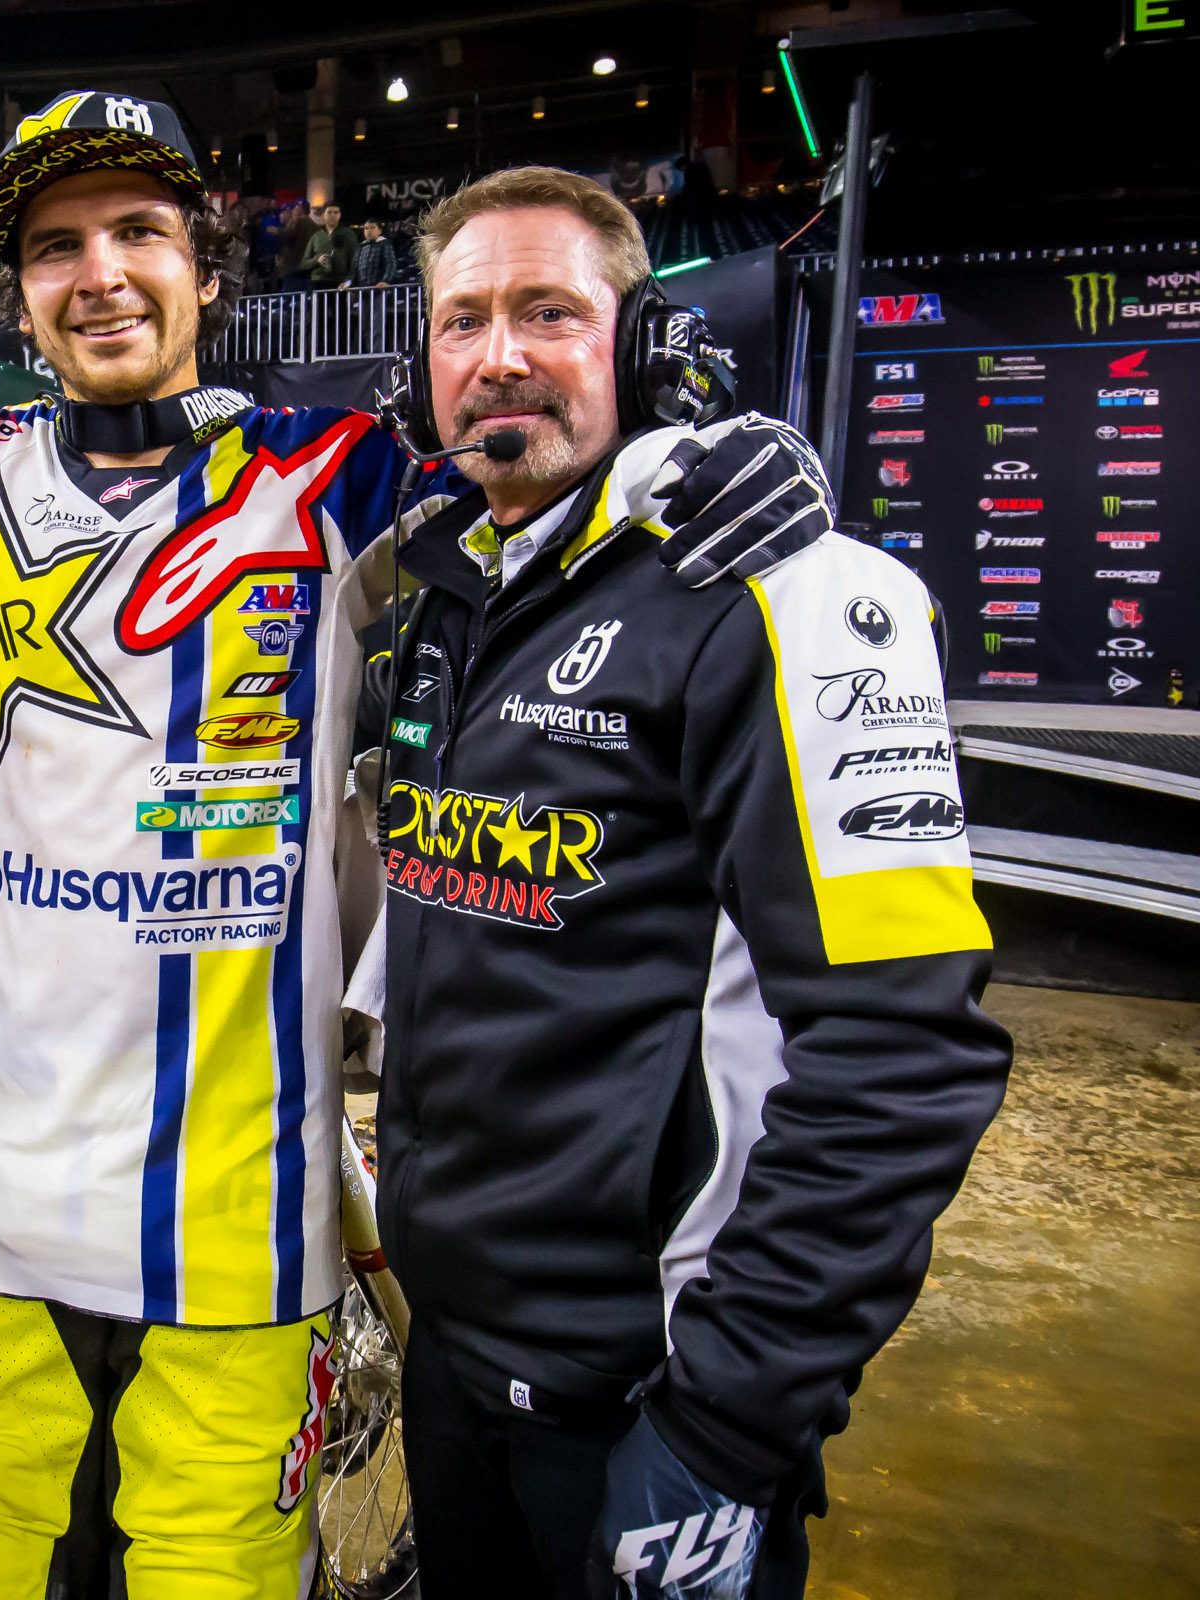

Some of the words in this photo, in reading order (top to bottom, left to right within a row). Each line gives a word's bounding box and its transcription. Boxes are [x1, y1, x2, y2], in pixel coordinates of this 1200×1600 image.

[857, 293, 946, 326] AMA
[875, 363, 916, 380] FS1
[1097, 387, 1160, 398] GoPro
[882, 531, 924, 541] oPro
[991, 537, 1046, 547] THOR
[237, 584, 311, 611] AMA
[265, 631, 285, 645] FIM
[499, 694, 628, 734] Husqvarna
[862, 716, 918, 728] CHEVROLET
[196, 716, 301, 743] FMF
[547, 733, 588, 747] FACTORY
[589, 740, 630, 750] RACING
[176, 765, 298, 783] SCOSCHE
[855, 765, 907, 777] RACING
[179, 798, 294, 828] MOTOREX
[3, 850, 288, 922] Husqvarna
[446, 867, 556, 923] DRINK
[135, 926, 216, 945] FACTORY
[221, 921, 281, 940] RACING
[612, 1502, 756, 1591] FLY
